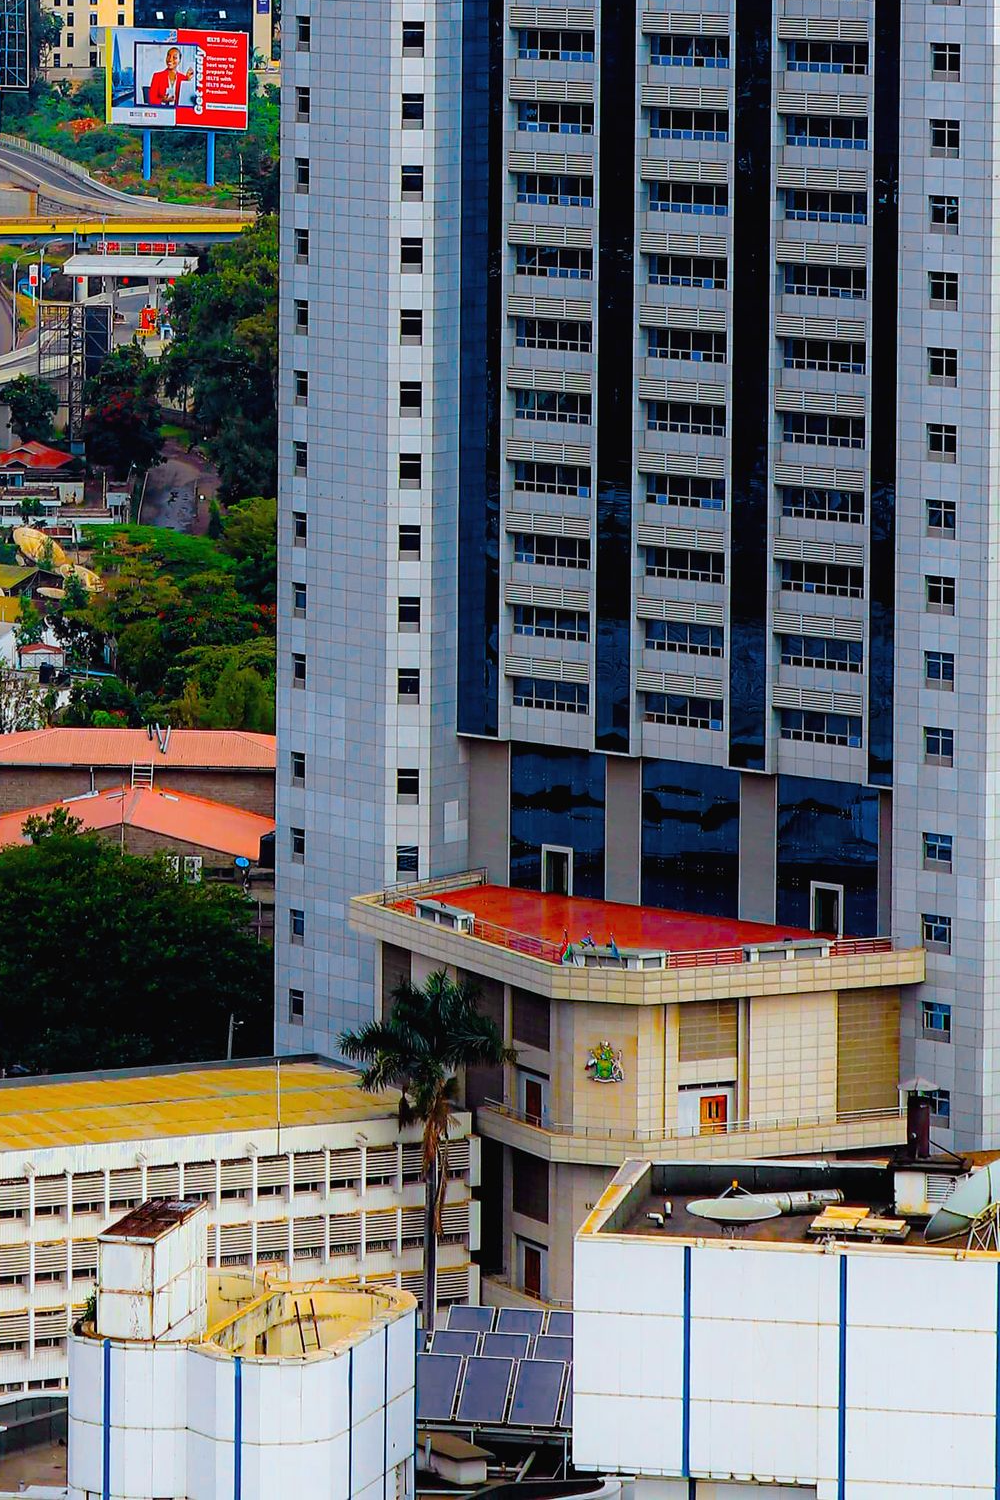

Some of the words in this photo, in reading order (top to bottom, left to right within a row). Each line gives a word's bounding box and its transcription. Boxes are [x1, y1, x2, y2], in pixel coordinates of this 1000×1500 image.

[221, 37, 238, 46] Ready
[195, 46, 206, 88] ready
[194, 90, 203, 115] Get
